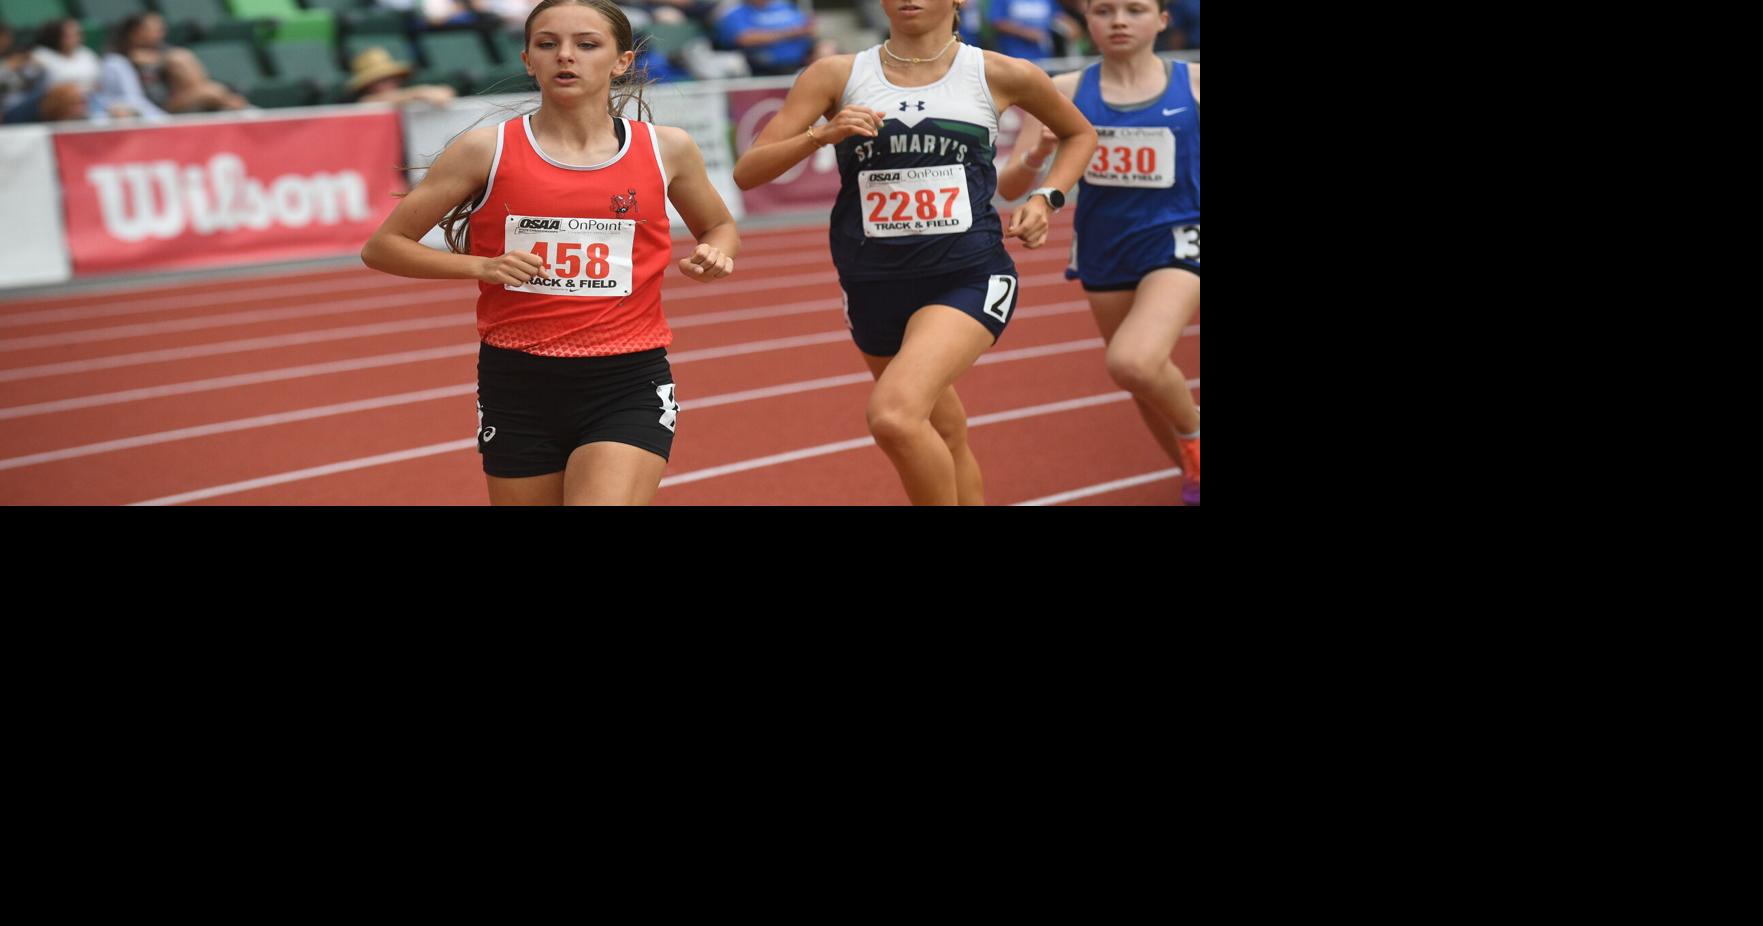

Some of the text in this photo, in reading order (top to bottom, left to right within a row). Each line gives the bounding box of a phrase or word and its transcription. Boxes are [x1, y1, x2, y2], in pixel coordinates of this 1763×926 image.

[854, 134, 968, 162] ST. MARY'S
[1091, 146, 1156, 174] 330
[868, 168, 954, 182] OSAA OnPoint
[85, 153, 371, 242] Wilson
[866, 187, 960, 222] 2287
[520, 218, 621, 230] OSAA OnPoint
[875, 222, 911, 230] TRACK
[926, 219, 960, 228] FIELD
[1184, 226, 1200, 260] 3
[526, 277, 617, 288] RACK & FIELD
[990, 277, 1012, 317] 2
